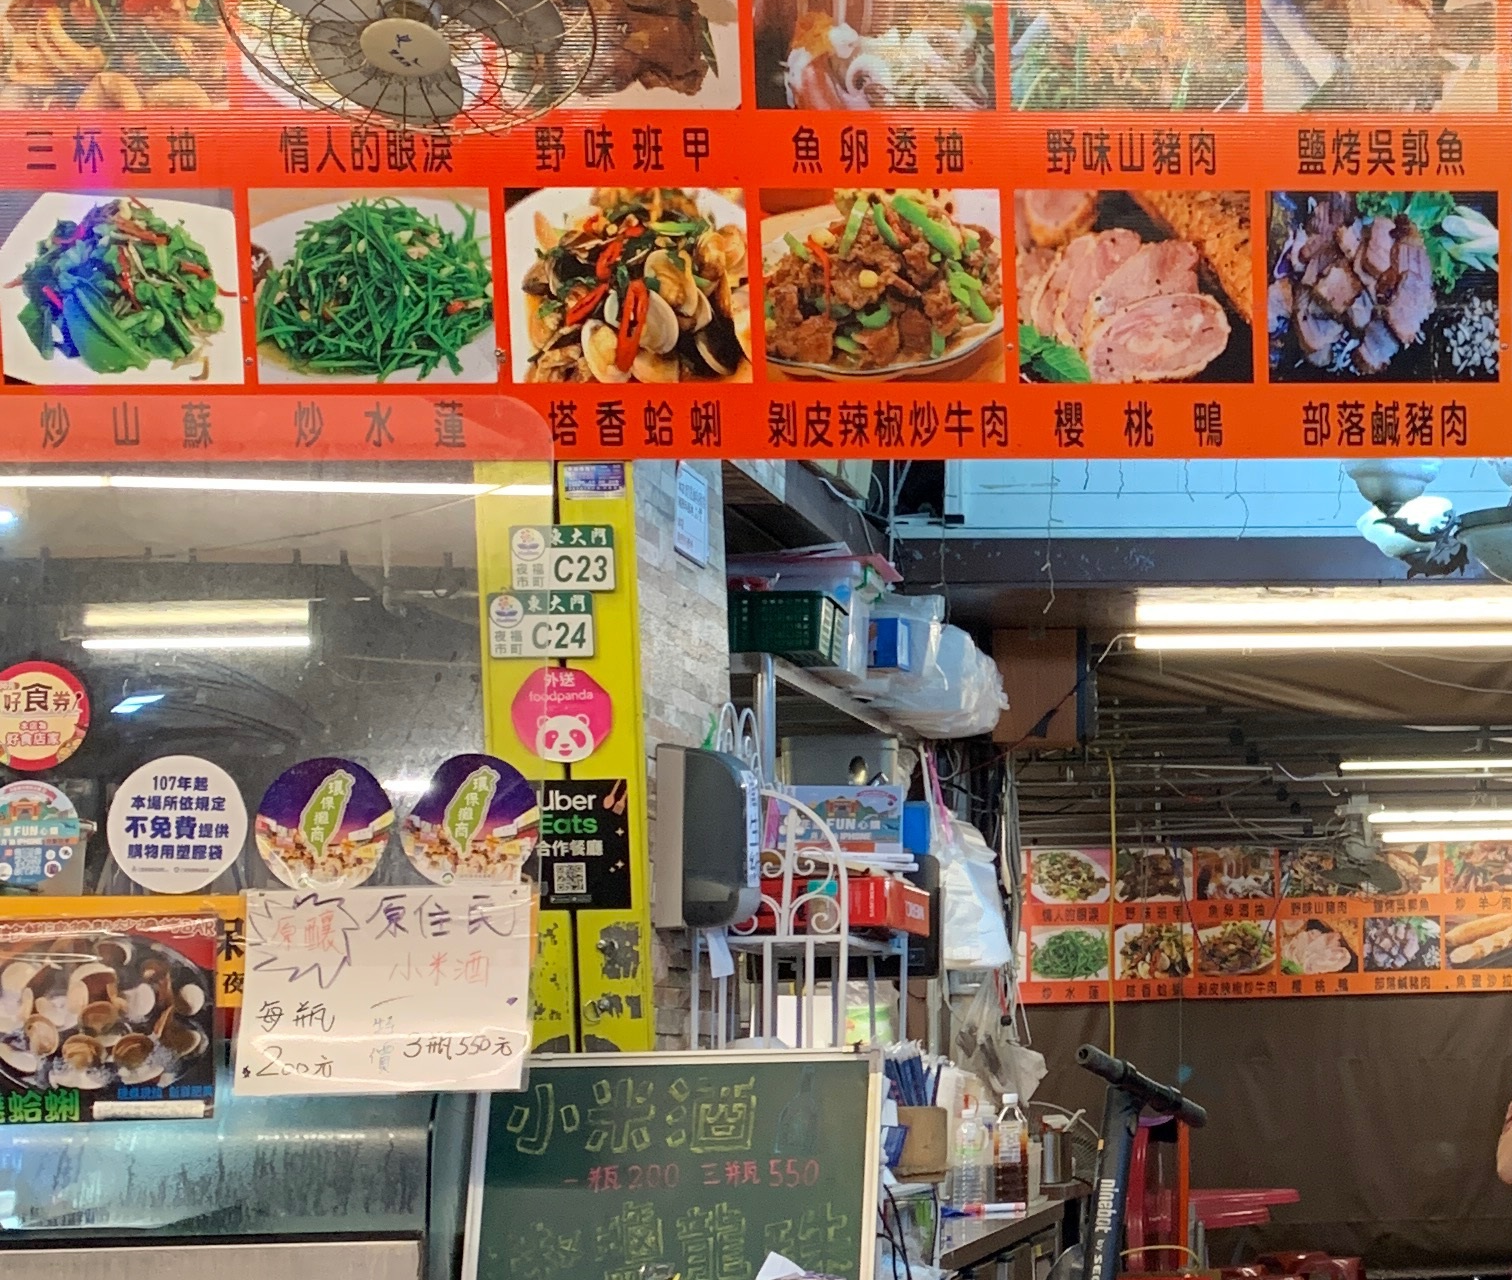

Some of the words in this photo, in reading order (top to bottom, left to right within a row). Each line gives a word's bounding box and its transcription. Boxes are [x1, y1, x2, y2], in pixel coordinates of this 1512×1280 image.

[25, 127, 198, 173] 三杯透抽
[279, 127, 453, 174] 情人的眼淚
[535, 126, 711, 173] 野味班甲
[792, 126, 964, 174] 魚卵透抽
[1045, 127, 1218, 175] 野味山豬肉
[1298, 127, 1465, 175] 鹽烤吳郭魚
[40, 401, 214, 448] 炒山蘇
[294, 401, 466, 448] 炒水蓮
[548, 400, 722, 447] 塔香蛤蜊
[767, 401, 1009, 448] 剝皮辣椒炒牛肉
[1054, 400, 1223, 447] 櫻桃鴨
[1302, 400, 1468, 447] 部落鹹豬肉
[551, 528, 606, 546] 東大門
[554, 555, 608, 582] C23
[528, 595, 585, 612] 東大門
[532, 622, 586, 649] C24
[529, 690, 593, 704] foodpanda
[544, 672, 575, 688] 外送
[152, 776, 208, 791] 107年起
[536, 790, 597, 811] Uber
[131, 796, 226, 812] 本場所依規定
[125, 815, 229, 839] 不免費提供
[540, 814, 598, 834] Eats
[127, 844, 223, 860] 購物用塑膠袋
[366, 894, 516, 939] 原住民
[388, 951, 490, 987] 小米酒
[257, 1001, 335, 1032] 每瓶
[404, 1034, 512, 1059] 3瓶550元
[1095, 1178, 1118, 1233] ninebot
